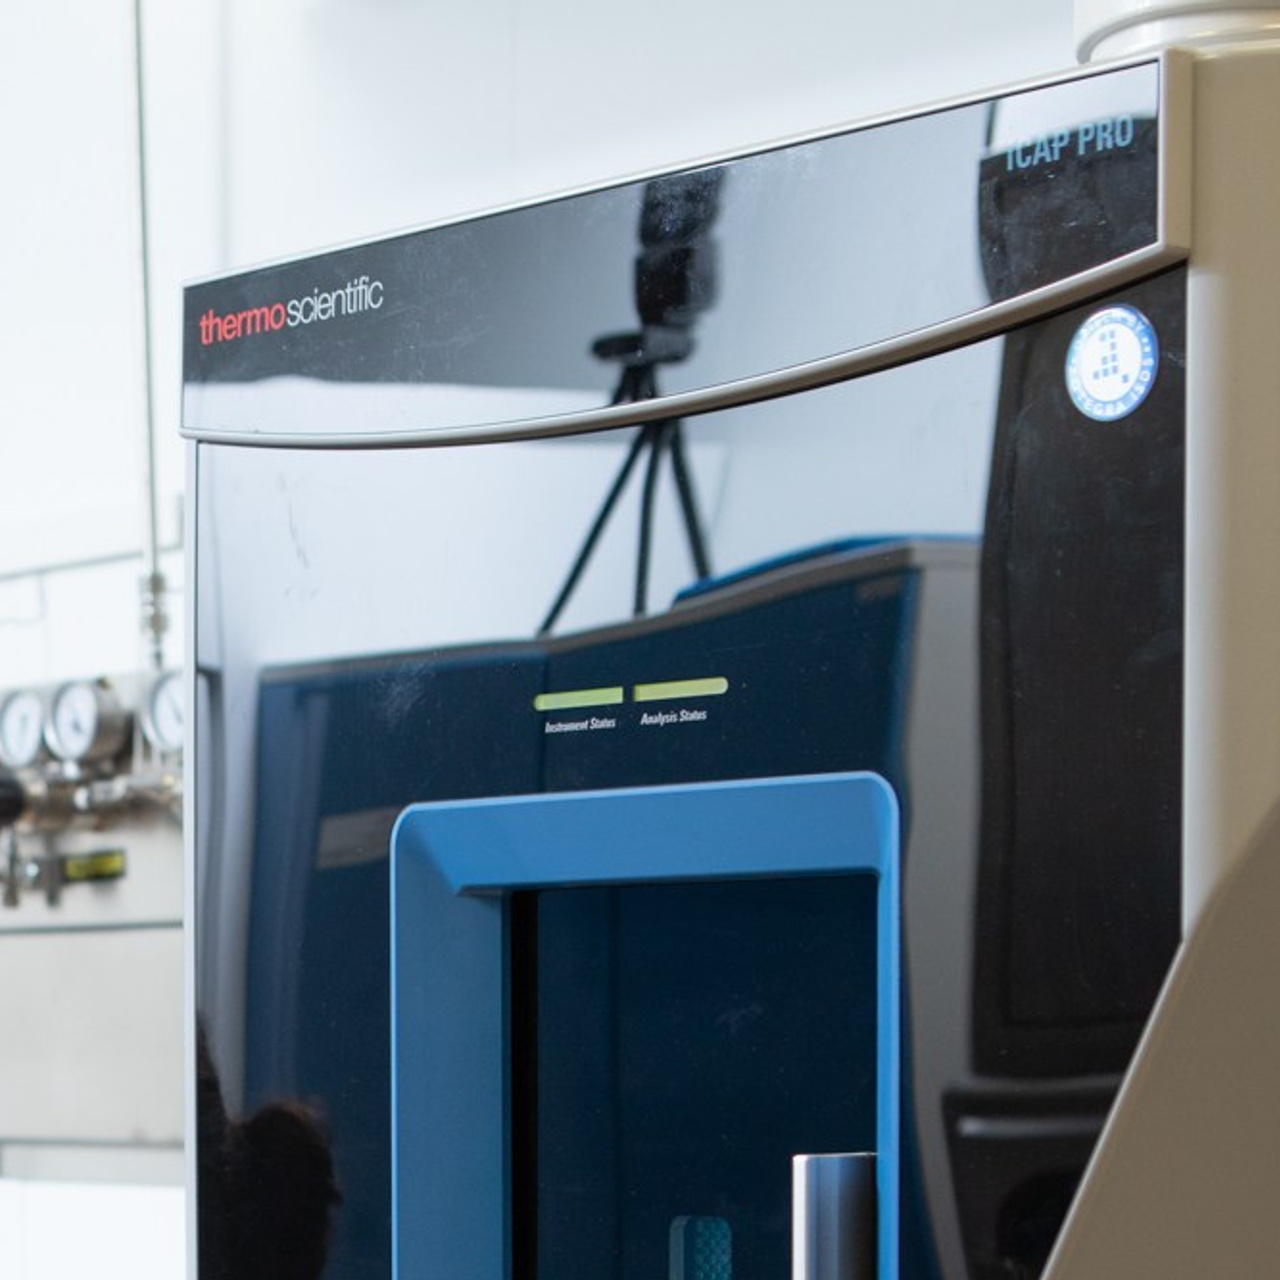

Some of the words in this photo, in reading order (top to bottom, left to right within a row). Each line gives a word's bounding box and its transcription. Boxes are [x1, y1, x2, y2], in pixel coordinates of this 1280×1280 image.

[1077, 114, 1134, 155] PRO
[545, 720, 588, 733] Instrument
[589, 716, 617, 729] Status
[640, 712, 678, 726] Analysis
[679, 708, 708, 722] Status
